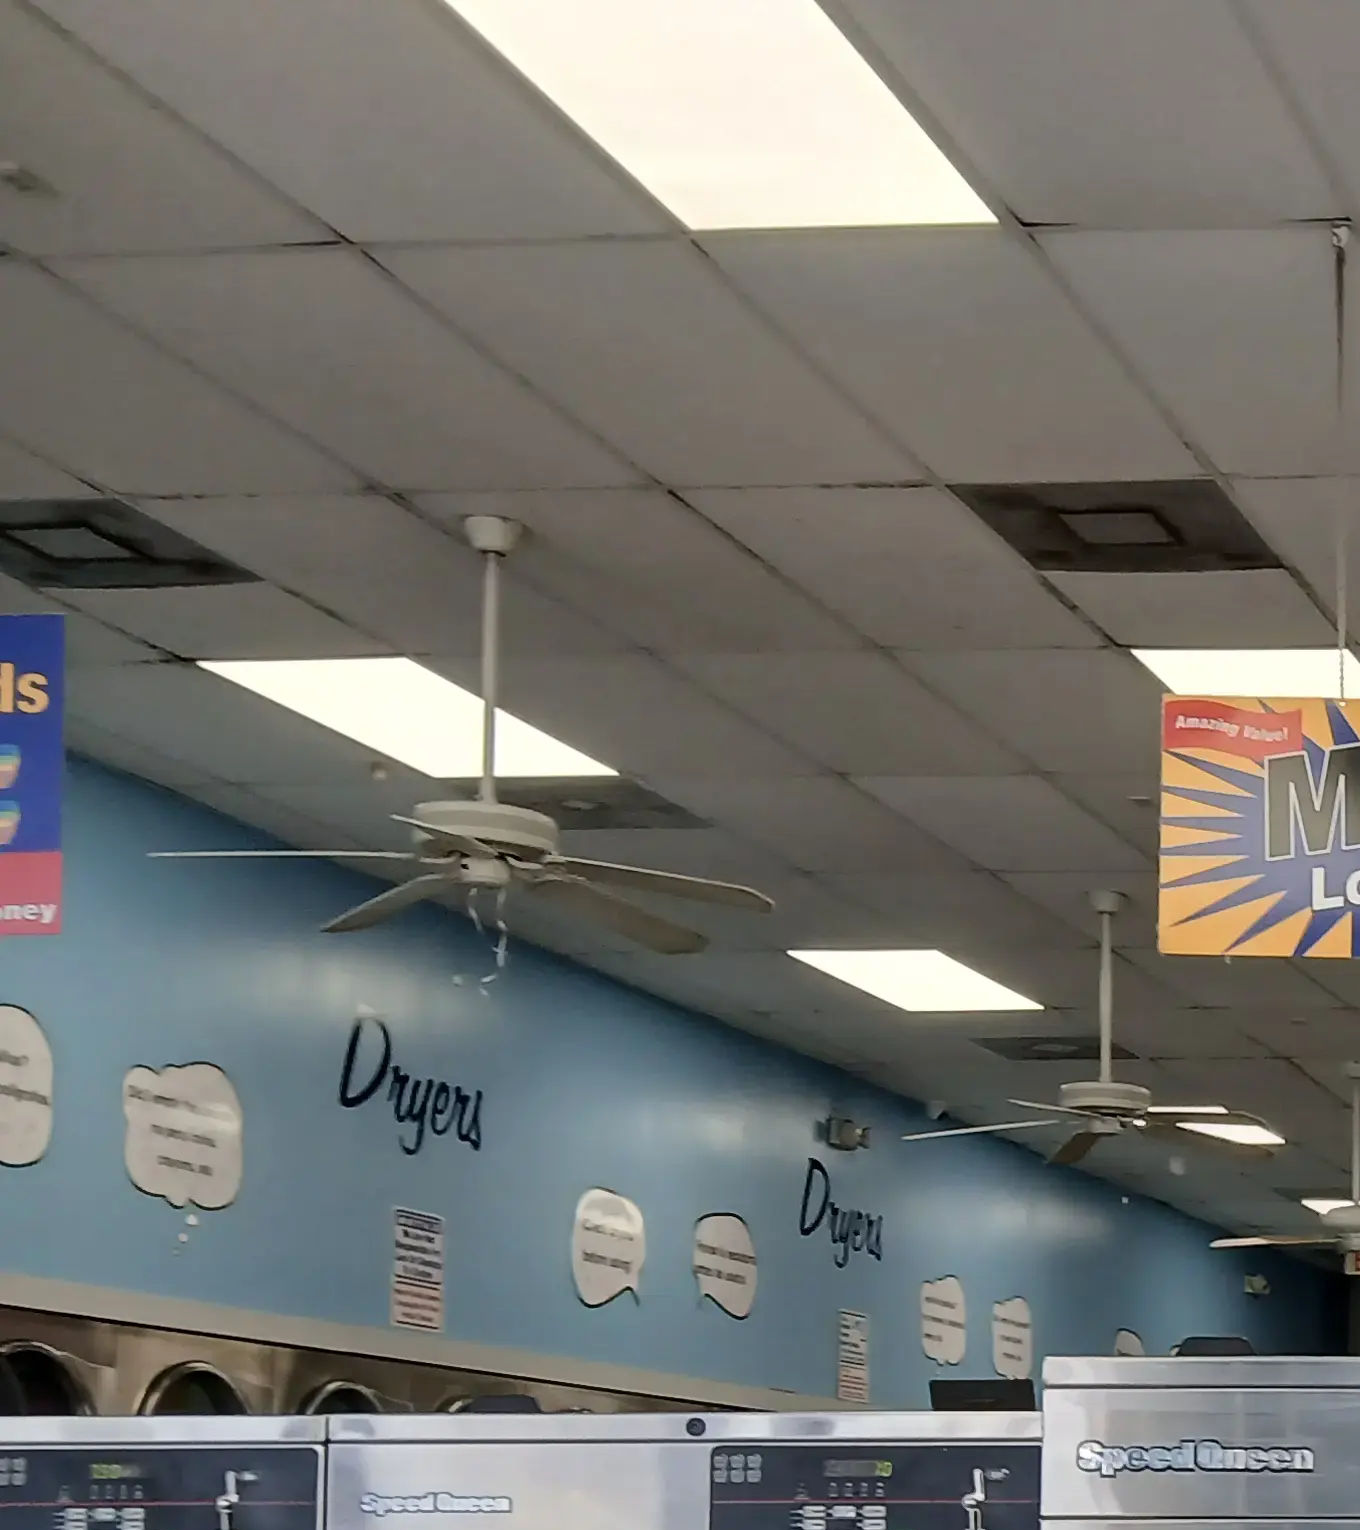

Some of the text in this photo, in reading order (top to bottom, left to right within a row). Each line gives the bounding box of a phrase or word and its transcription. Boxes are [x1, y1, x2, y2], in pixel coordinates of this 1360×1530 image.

[1175, 714, 1240, 737] Amazing
[339, 1008, 483, 1156] Dryers
[1077, 1439, 1314, 1478] Speed Queen
